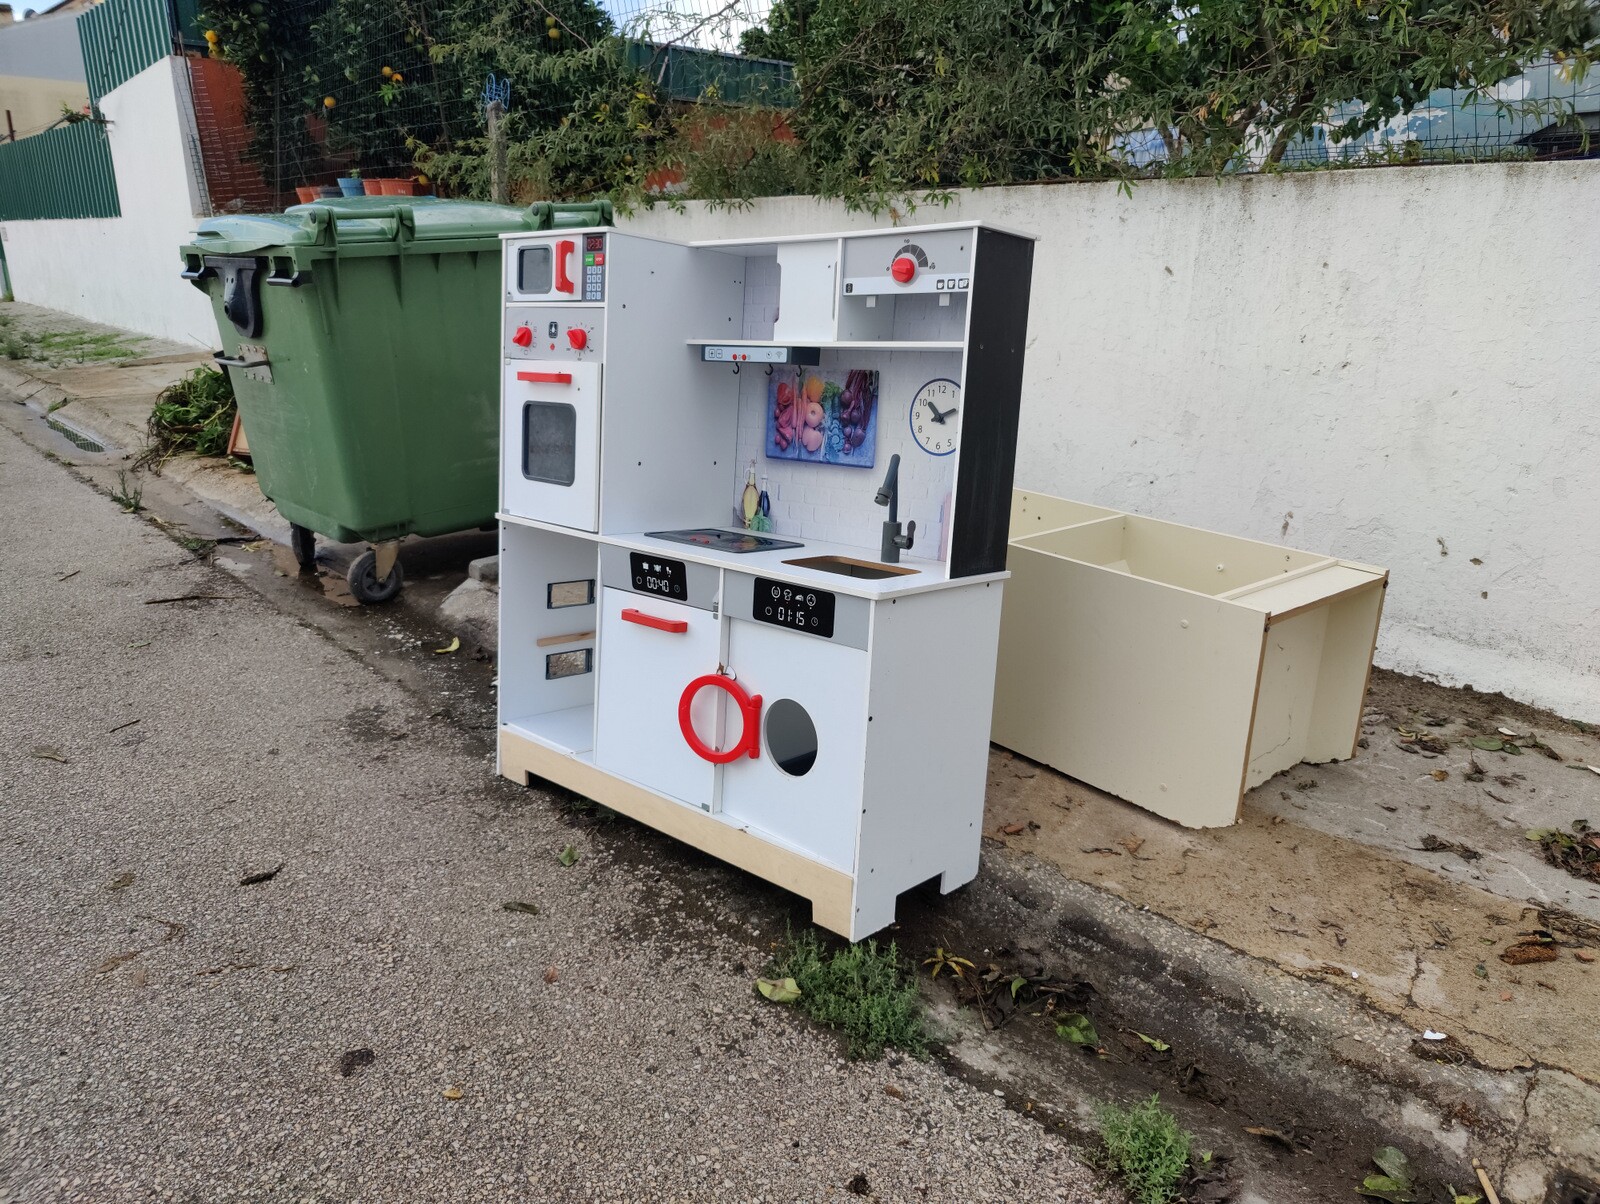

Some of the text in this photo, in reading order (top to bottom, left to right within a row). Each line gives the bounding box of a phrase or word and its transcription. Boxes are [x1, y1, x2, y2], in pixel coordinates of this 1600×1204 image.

[928, 389, 935, 397] 11
[938, 385, 946, 394] 12
[952, 390, 955, 398] 1
[919, 398, 928, 406] 10
[916, 412, 920, 420] 9
[918, 425, 922, 434] 8
[926, 436, 930, 444] 7
[947, 438, 952, 447] 5
[936, 442, 940, 450] 6
[646, 576, 670, 592] 00:40
[778, 606, 805, 626] 01:15
